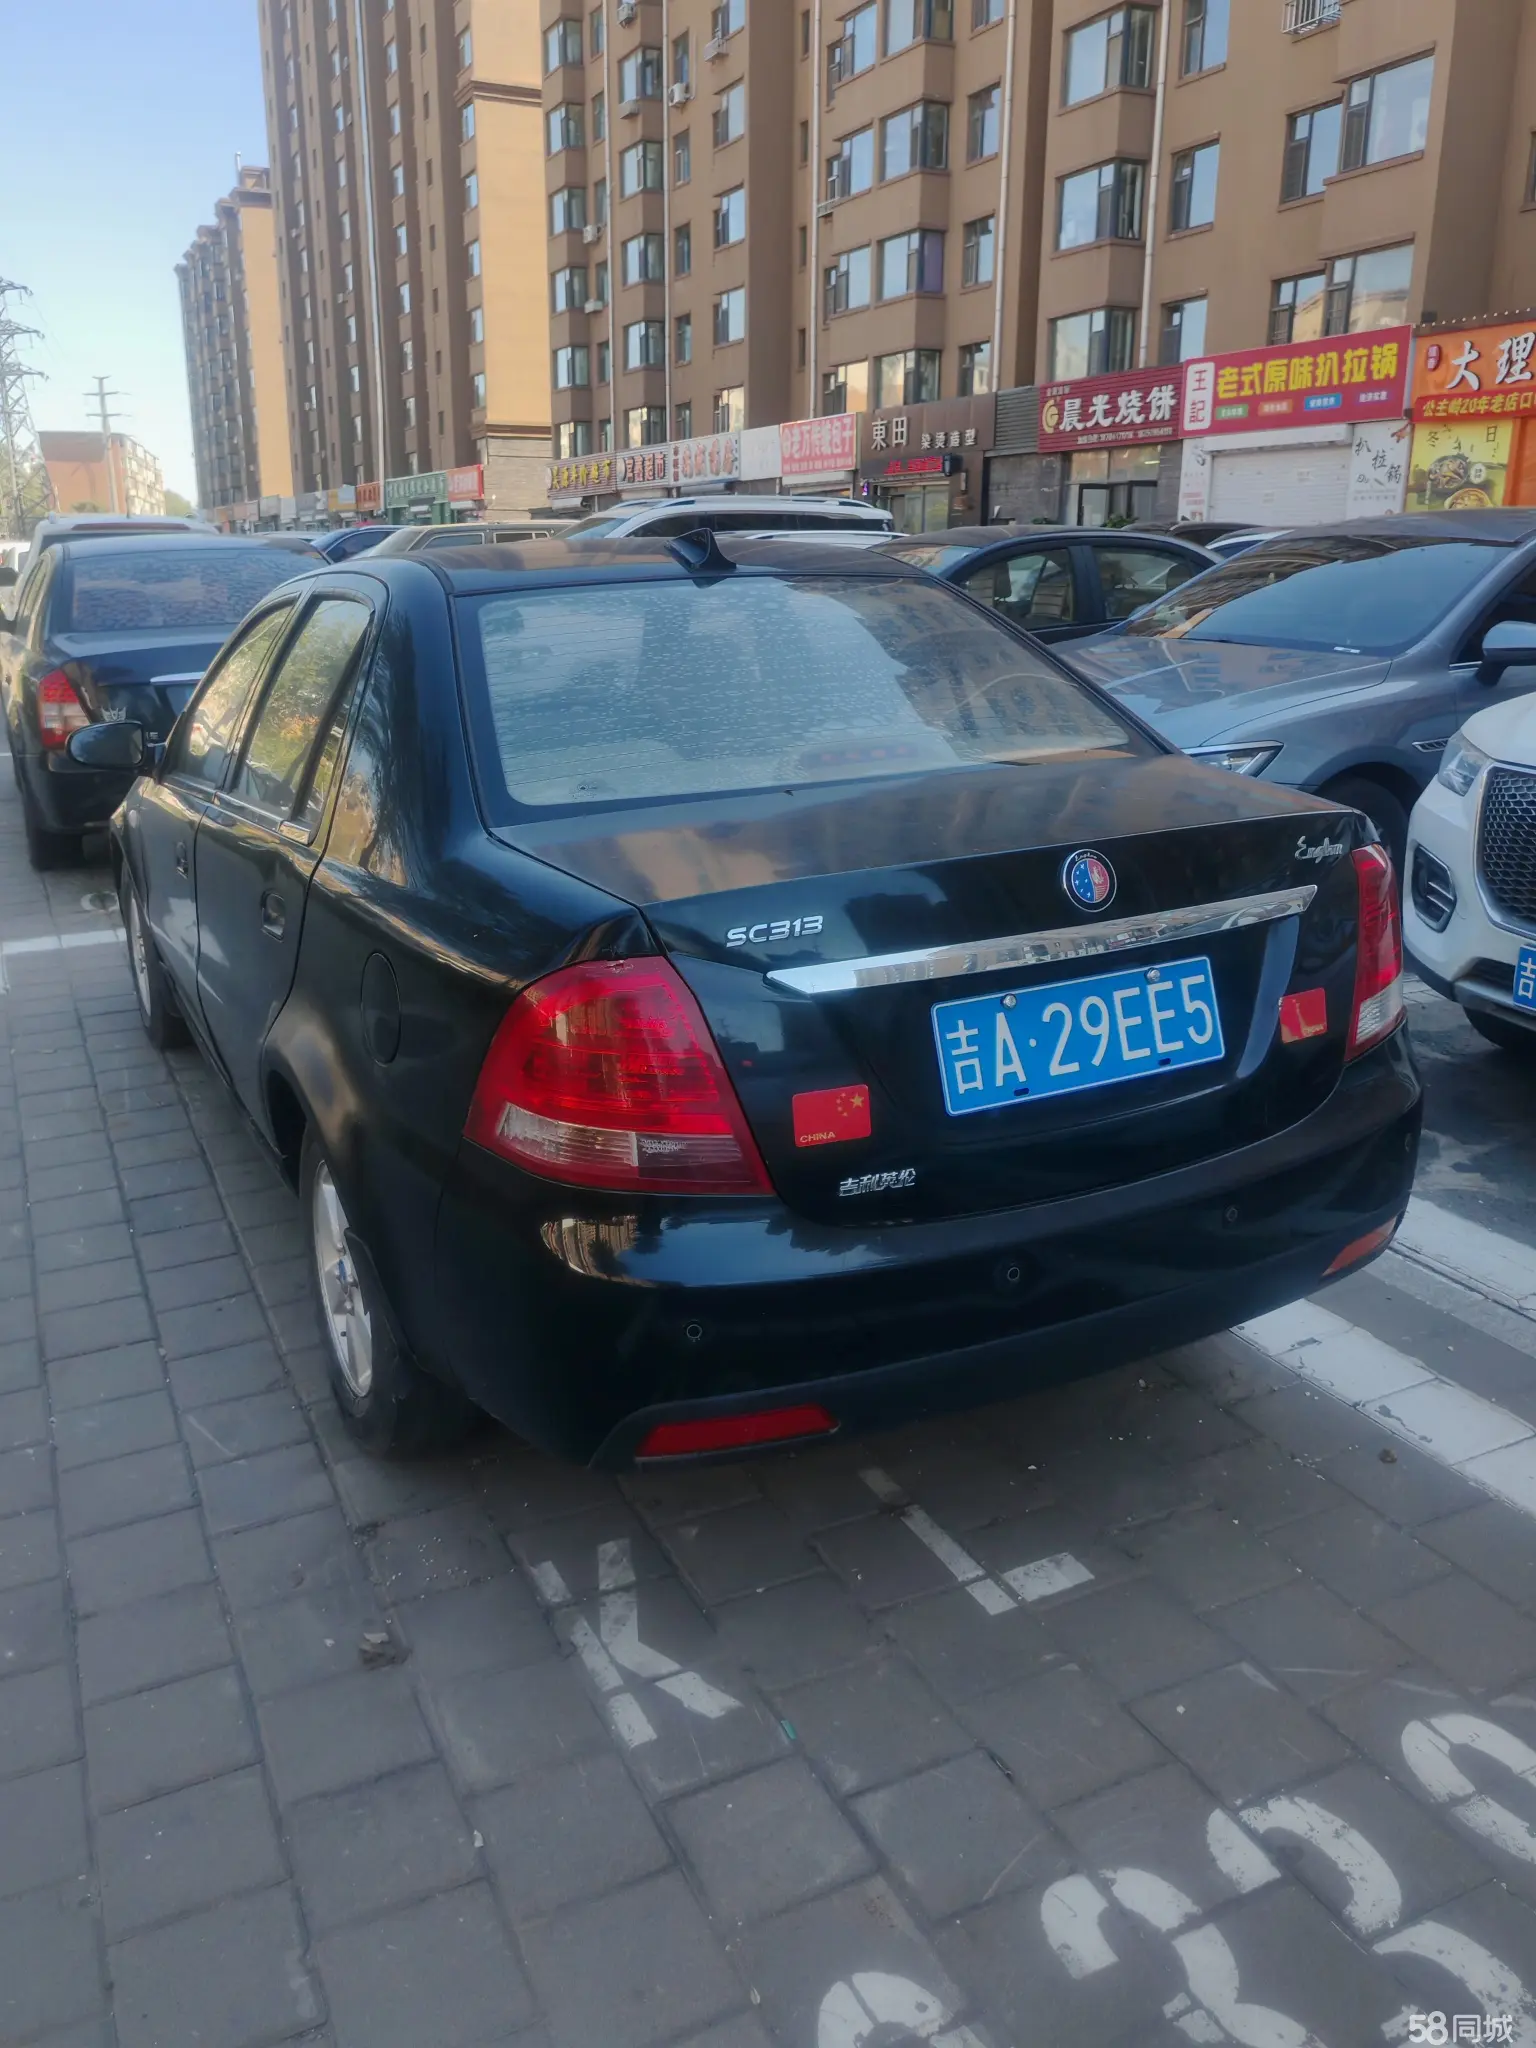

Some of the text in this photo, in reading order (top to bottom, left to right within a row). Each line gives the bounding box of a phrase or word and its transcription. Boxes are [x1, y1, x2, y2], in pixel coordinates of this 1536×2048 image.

[1216, 343, 1399, 398] 老式原味扒拉锅
[1446, 332, 1536, 391] 大理
[1059, 384, 1177, 432] 晨光烧饼
[1189, 369, 1208, 424] 王記
[1423, 391, 1536, 417] 公主岭20年老店口
[871, 416, 908, 451] 東田
[726, 915, 824, 948] SC313
[946, 974, 1213, 1094] 吉A·29EE5
[799, 1131, 836, 1143] CHINA
[839, 1168, 916, 1197] 吉利英伦
